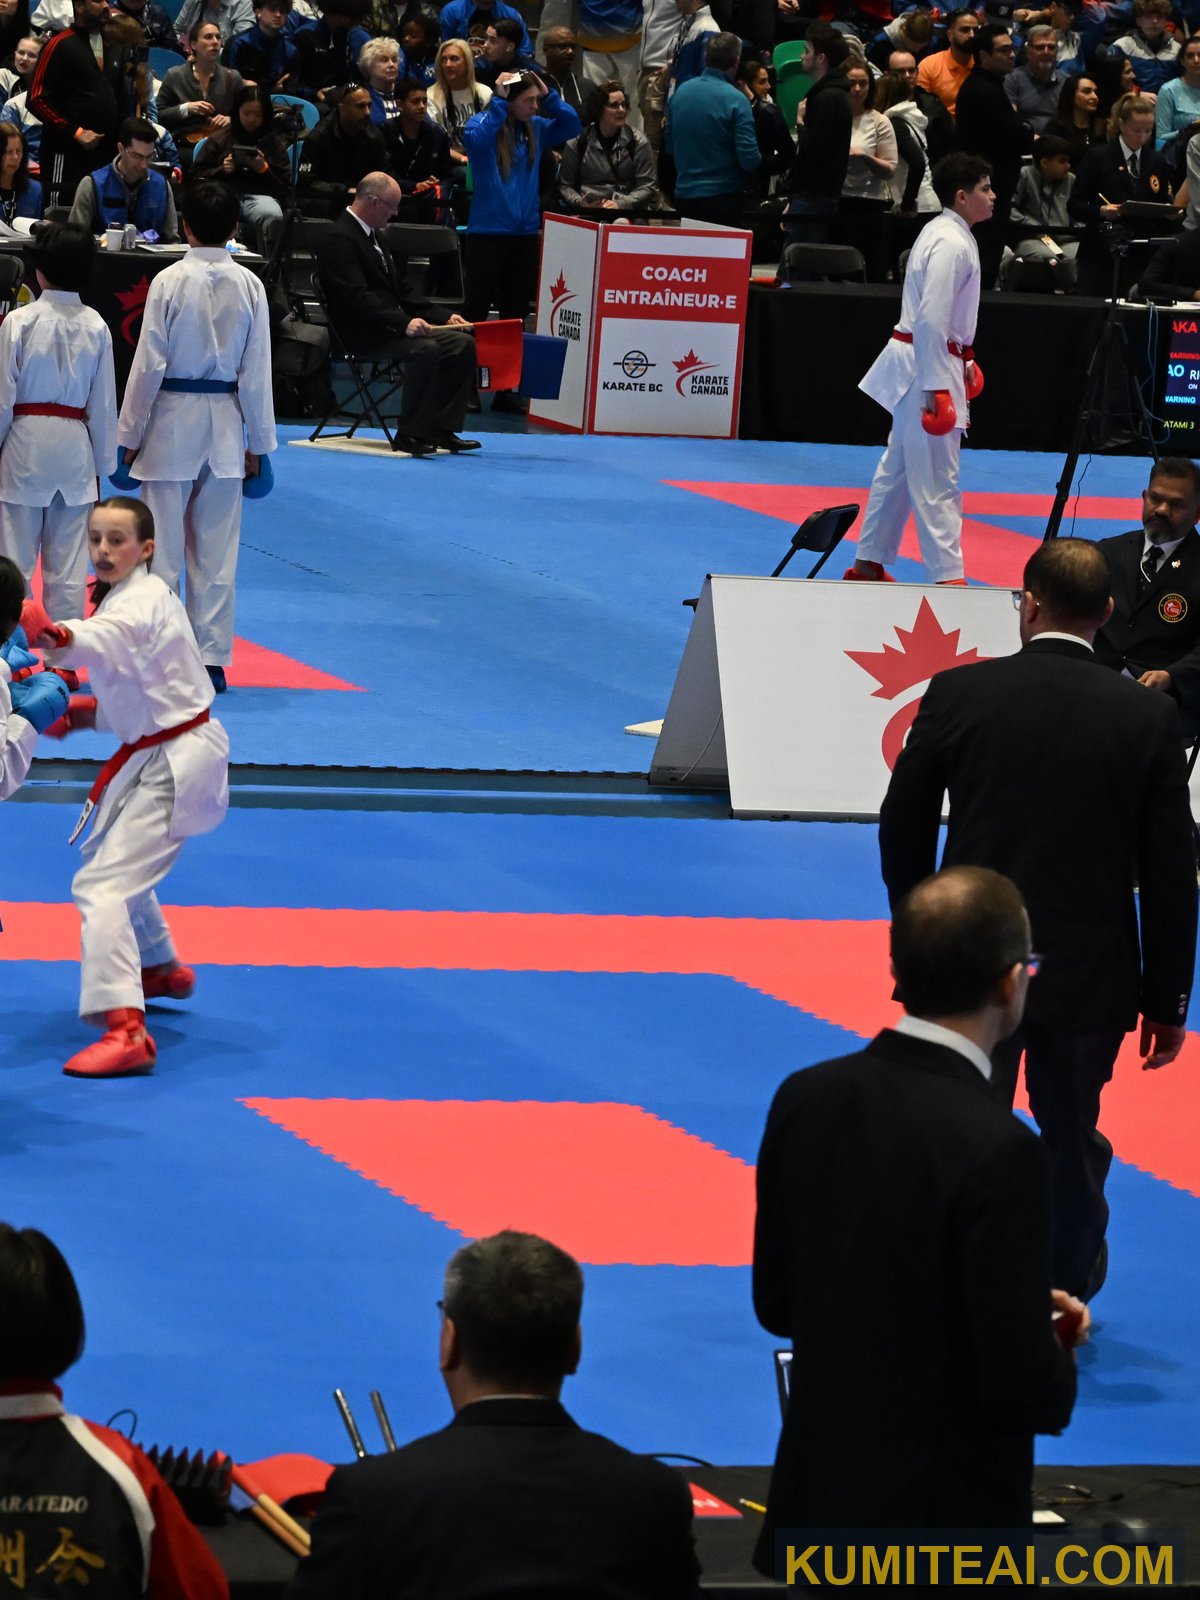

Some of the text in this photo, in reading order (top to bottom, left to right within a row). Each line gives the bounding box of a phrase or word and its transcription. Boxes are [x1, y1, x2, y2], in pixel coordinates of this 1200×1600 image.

[641, 266, 708, 283] COACH
[604, 288, 737, 310] ENTRAÎNEUR·E
[559, 308, 582, 327] KARATE
[558, 324, 581, 342] CANADA
[602, 381, 663, 393] KARATE BC
[691, 375, 730, 386] KARATE
[690, 385, 729, 396] CANADA
[1163, 420, 1195, 430] ATAMI 3
